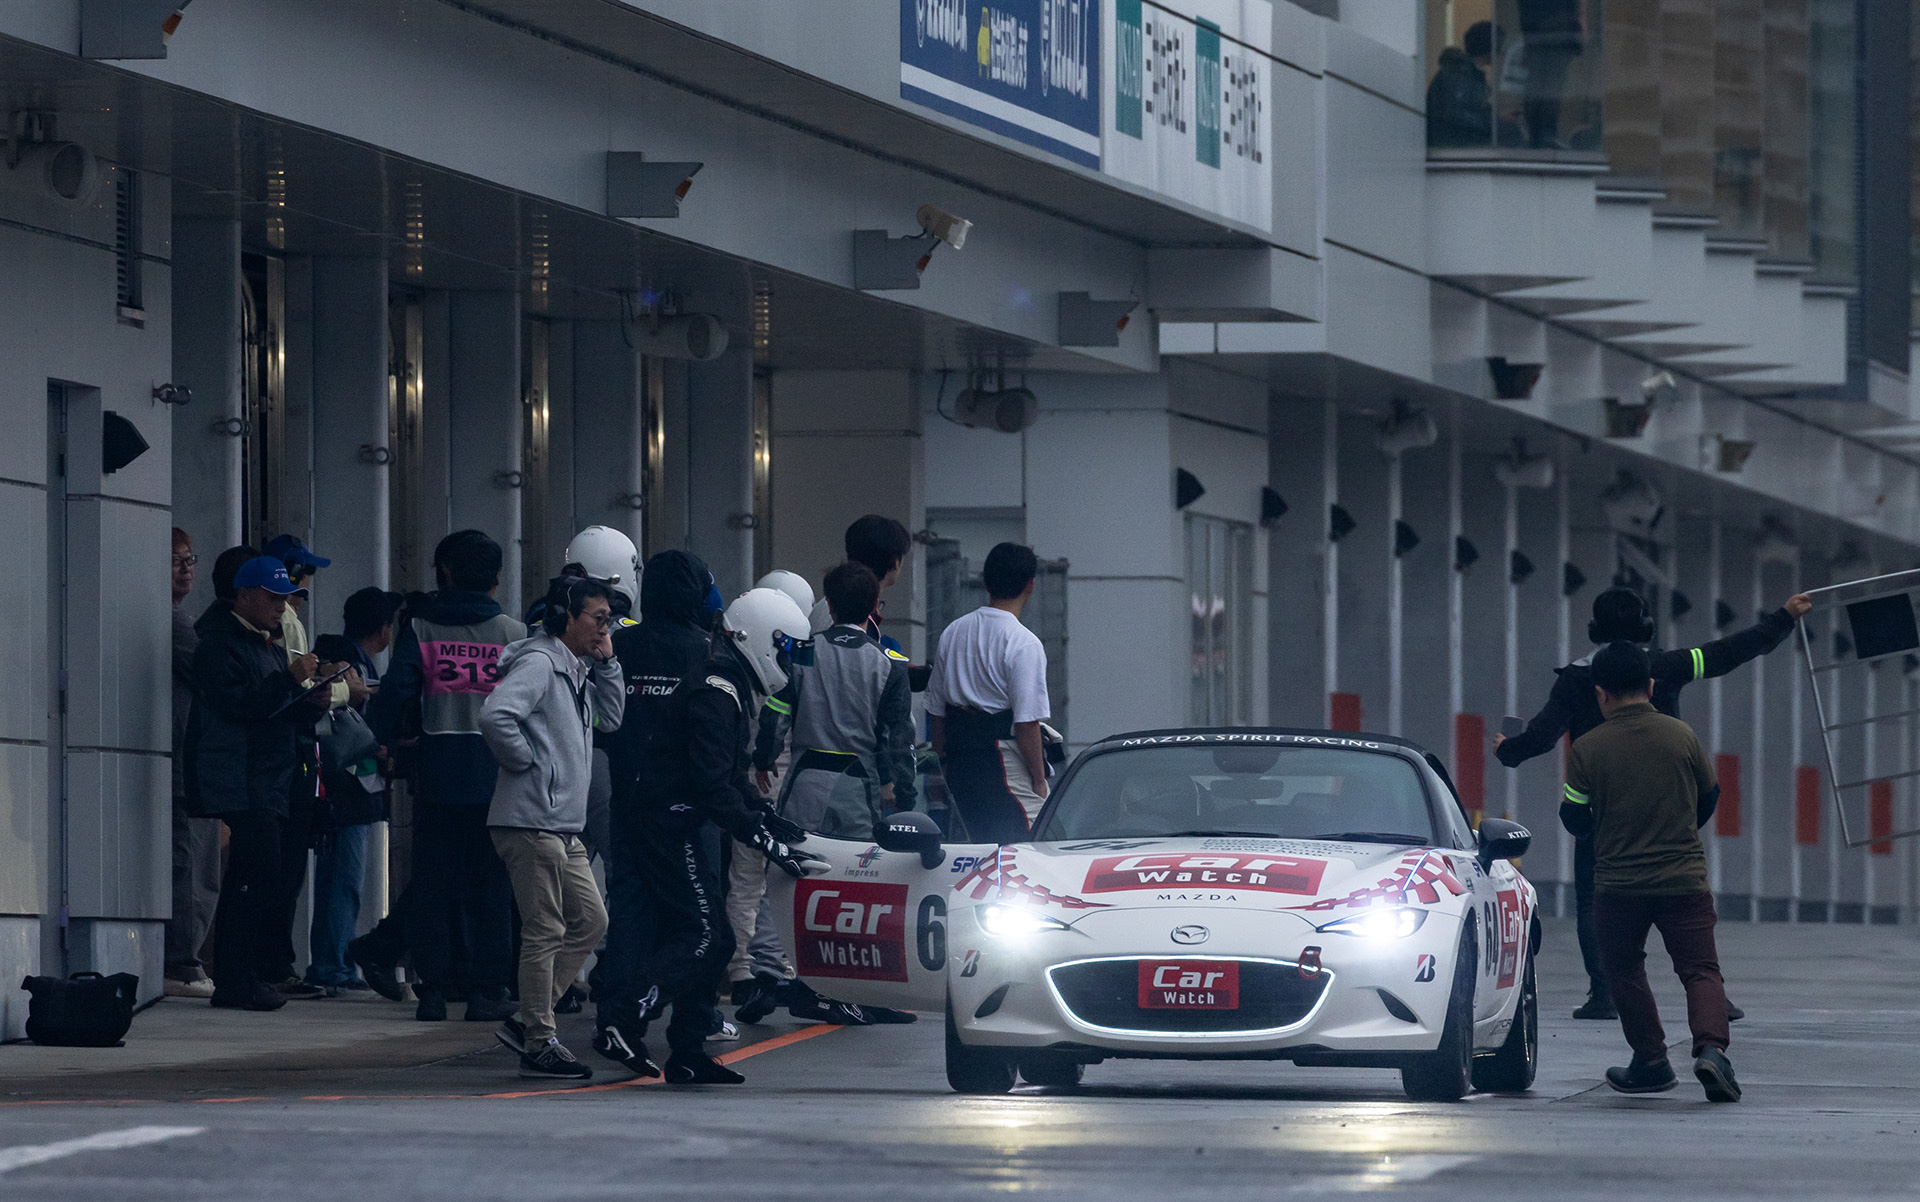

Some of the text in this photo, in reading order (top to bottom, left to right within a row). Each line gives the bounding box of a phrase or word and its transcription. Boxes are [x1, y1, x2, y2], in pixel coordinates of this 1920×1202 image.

[440, 643, 499, 659] MEDIA
[437, 659, 504, 684] 319
[626, 685, 674, 696] OFFICIA
[1122, 734, 1379, 749] MAZDA SPIRIT RACING
[889, 824, 919, 833] KTEL
[1113, 854, 1298, 871] Car
[844, 866, 879, 877] impress
[1137, 870, 1267, 885] Watch
[1156, 893, 1237, 901] MAZDA
[805, 889, 893, 935] Car
[1501, 901, 1519, 943] Car
[1484, 900, 1499, 977] 64
[818, 940, 882, 968] Watch
[1153, 966, 1224, 988] Car
[1163, 991, 1215, 1005] Watch
